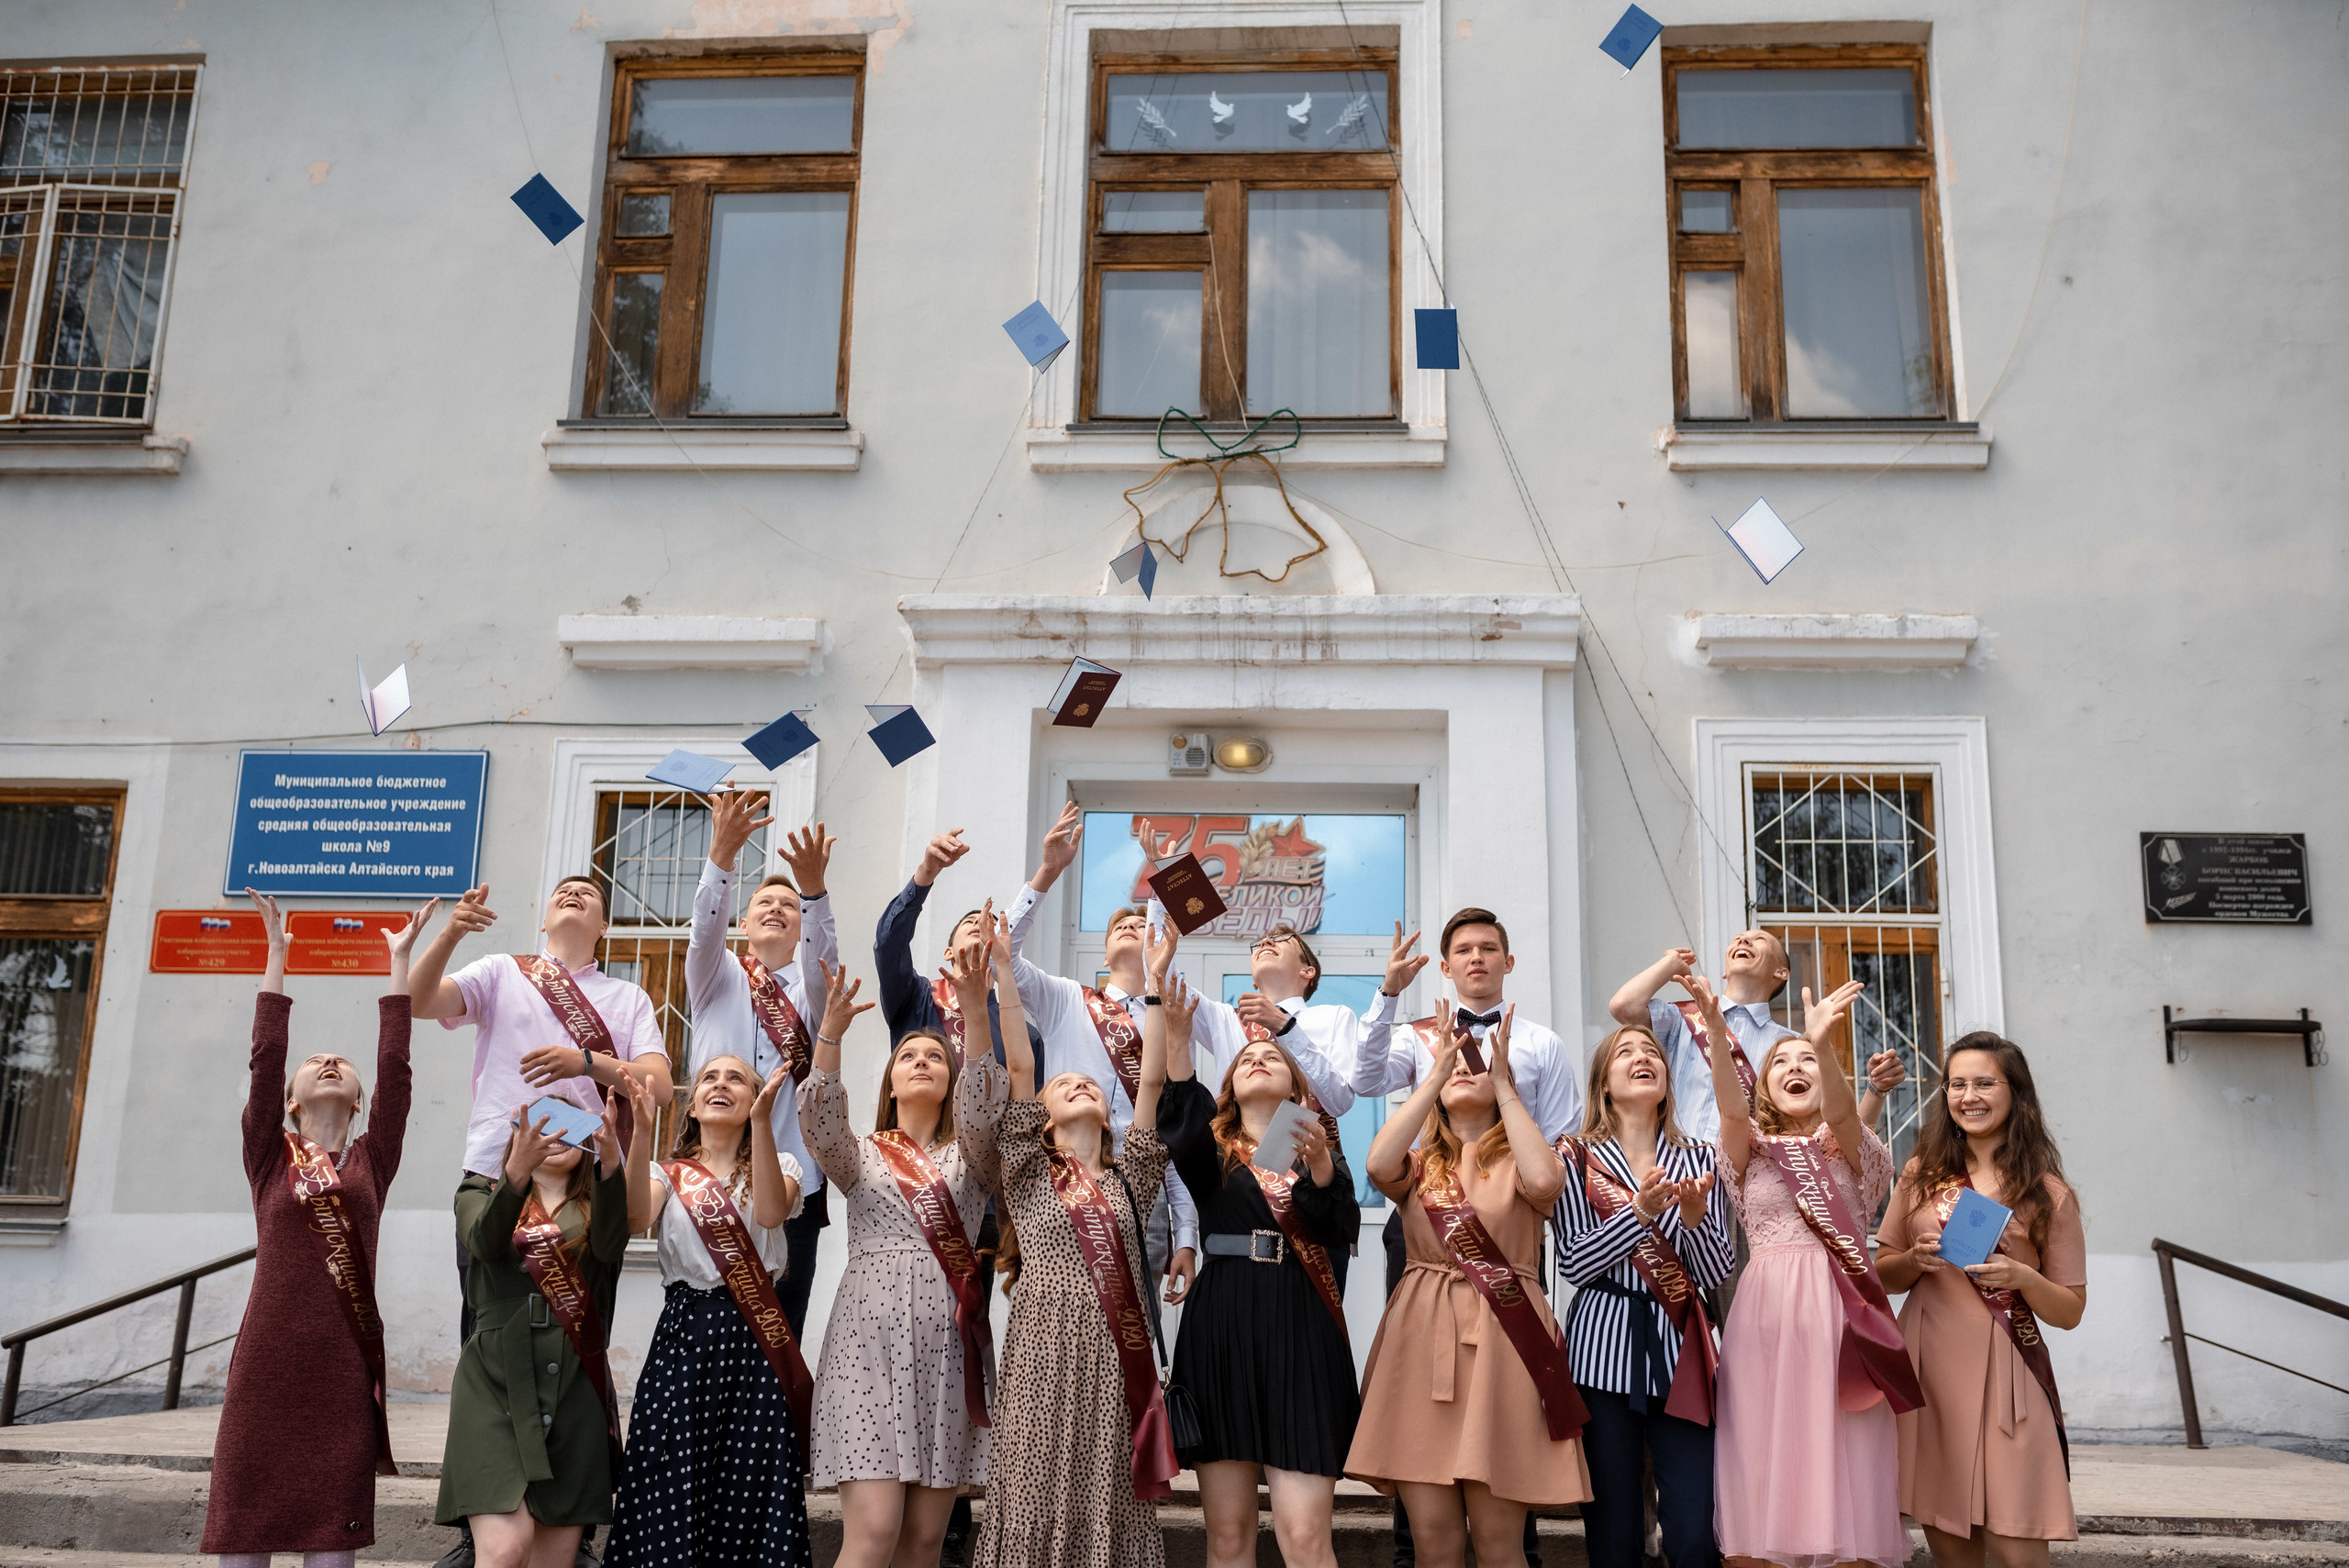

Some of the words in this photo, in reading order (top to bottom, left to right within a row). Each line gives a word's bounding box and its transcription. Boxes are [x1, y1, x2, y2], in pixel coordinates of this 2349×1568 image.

[250, 795, 387, 811] общеобразовательное
[390, 798, 466, 812] учреждение
[274, 774, 373, 789] Муниципальное
[376, 775, 447, 789] бюджетное
[258, 819, 308, 833] средняя
[312, 818, 451, 833] общеобразовательная
[321, 841, 362, 852] школа
[365, 840, 391, 853] №9
[248, 861, 345, 875] г.Новоалтайска
[349, 862, 421, 876] Алтайского
[424, 864, 454, 878] края
[1130, 815, 1251, 903] 75
[1260, 857, 1319, 880] ЛЕТ
[1166, 873, 1193, 892] АТТЕСТАТ
[1213, 879, 1325, 907] ЕЛИКОЙ
[536, 962, 597, 1048] Выпускник
[751, 973, 809, 1074] Выпускник
[1778, 1137, 1838, 1235] ыпускница
[1824, 1232, 1867, 1273] 2020
[301, 1165, 364, 1297] Выпускница
[522, 1228, 584, 1318] ыпускница
[693, 1186, 764, 1311] Выпускница
[753, 1306, 791, 1350] 2020
[937, 1235, 974, 1277] 2020
[1066, 1179, 1126, 1305] Выпускница
[1115, 1308, 1146, 1351] 2020
[1479, 1265, 1524, 1310] 2020
[1650, 1260, 1694, 1305] 2020
[2003, 1304, 2041, 1347] 2020
